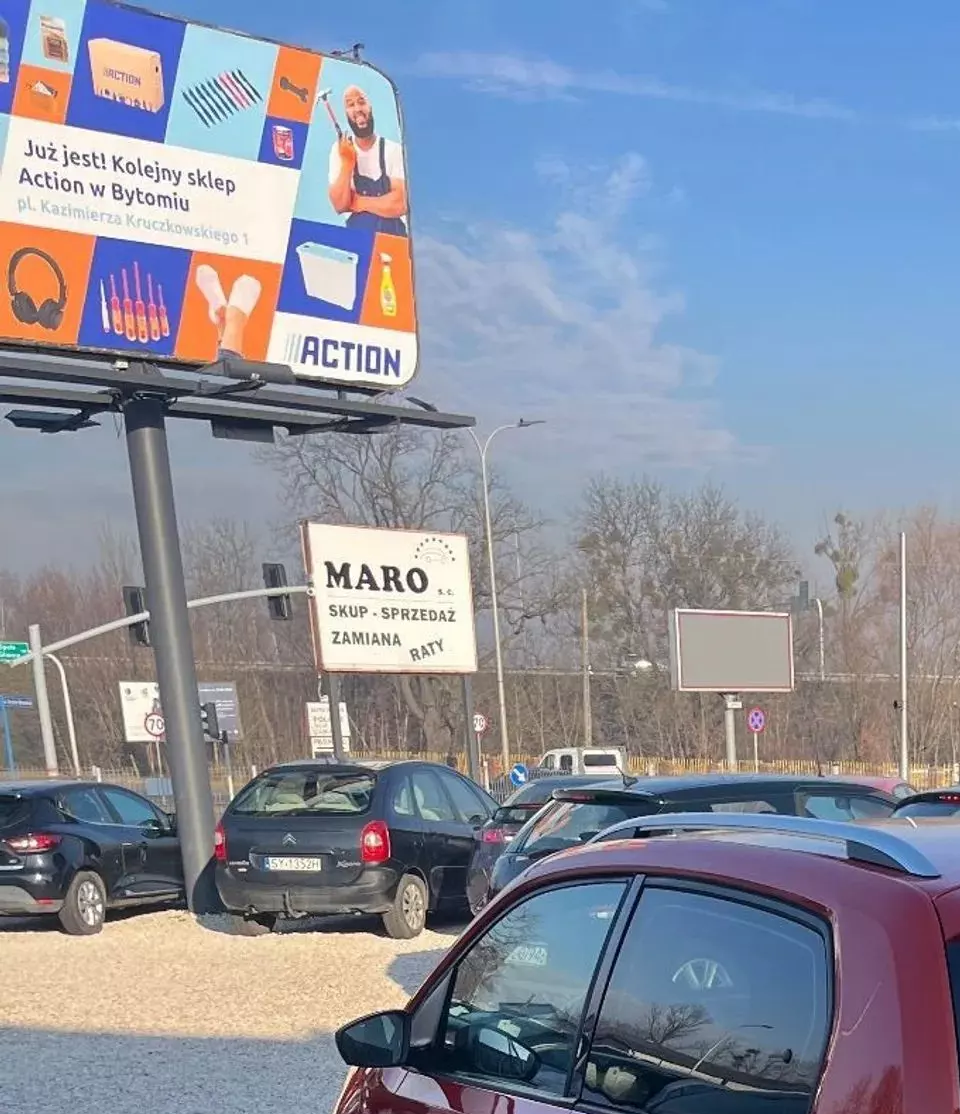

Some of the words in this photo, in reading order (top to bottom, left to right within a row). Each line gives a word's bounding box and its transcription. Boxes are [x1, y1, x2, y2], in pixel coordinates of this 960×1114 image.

[24, 139, 58, 162] Już
[62, 146, 107, 170] jest!
[112, 155, 182, 186] Kolejny
[187, 167, 236, 195] sklep
[18, 167, 84, 195] Action
[90, 182, 105, 198] w
[112, 183, 190, 212] Bytomiu
[17, 196, 37, 214] pl.
[41, 199, 122, 226] Kazimierza
[126, 213, 238, 244] Kruczkowskiego
[243, 232, 249, 246] 1
[300, 335, 401, 378] ACTION
[324, 561, 429, 593] MARO
[328, 604, 369, 619] SKUP
[381, 606, 457, 623] SPRZEDAŻ
[332, 631, 402, 647] ZAMIANA
[409, 638, 445, 662] RATY
[148, 718, 164, 731] 70
